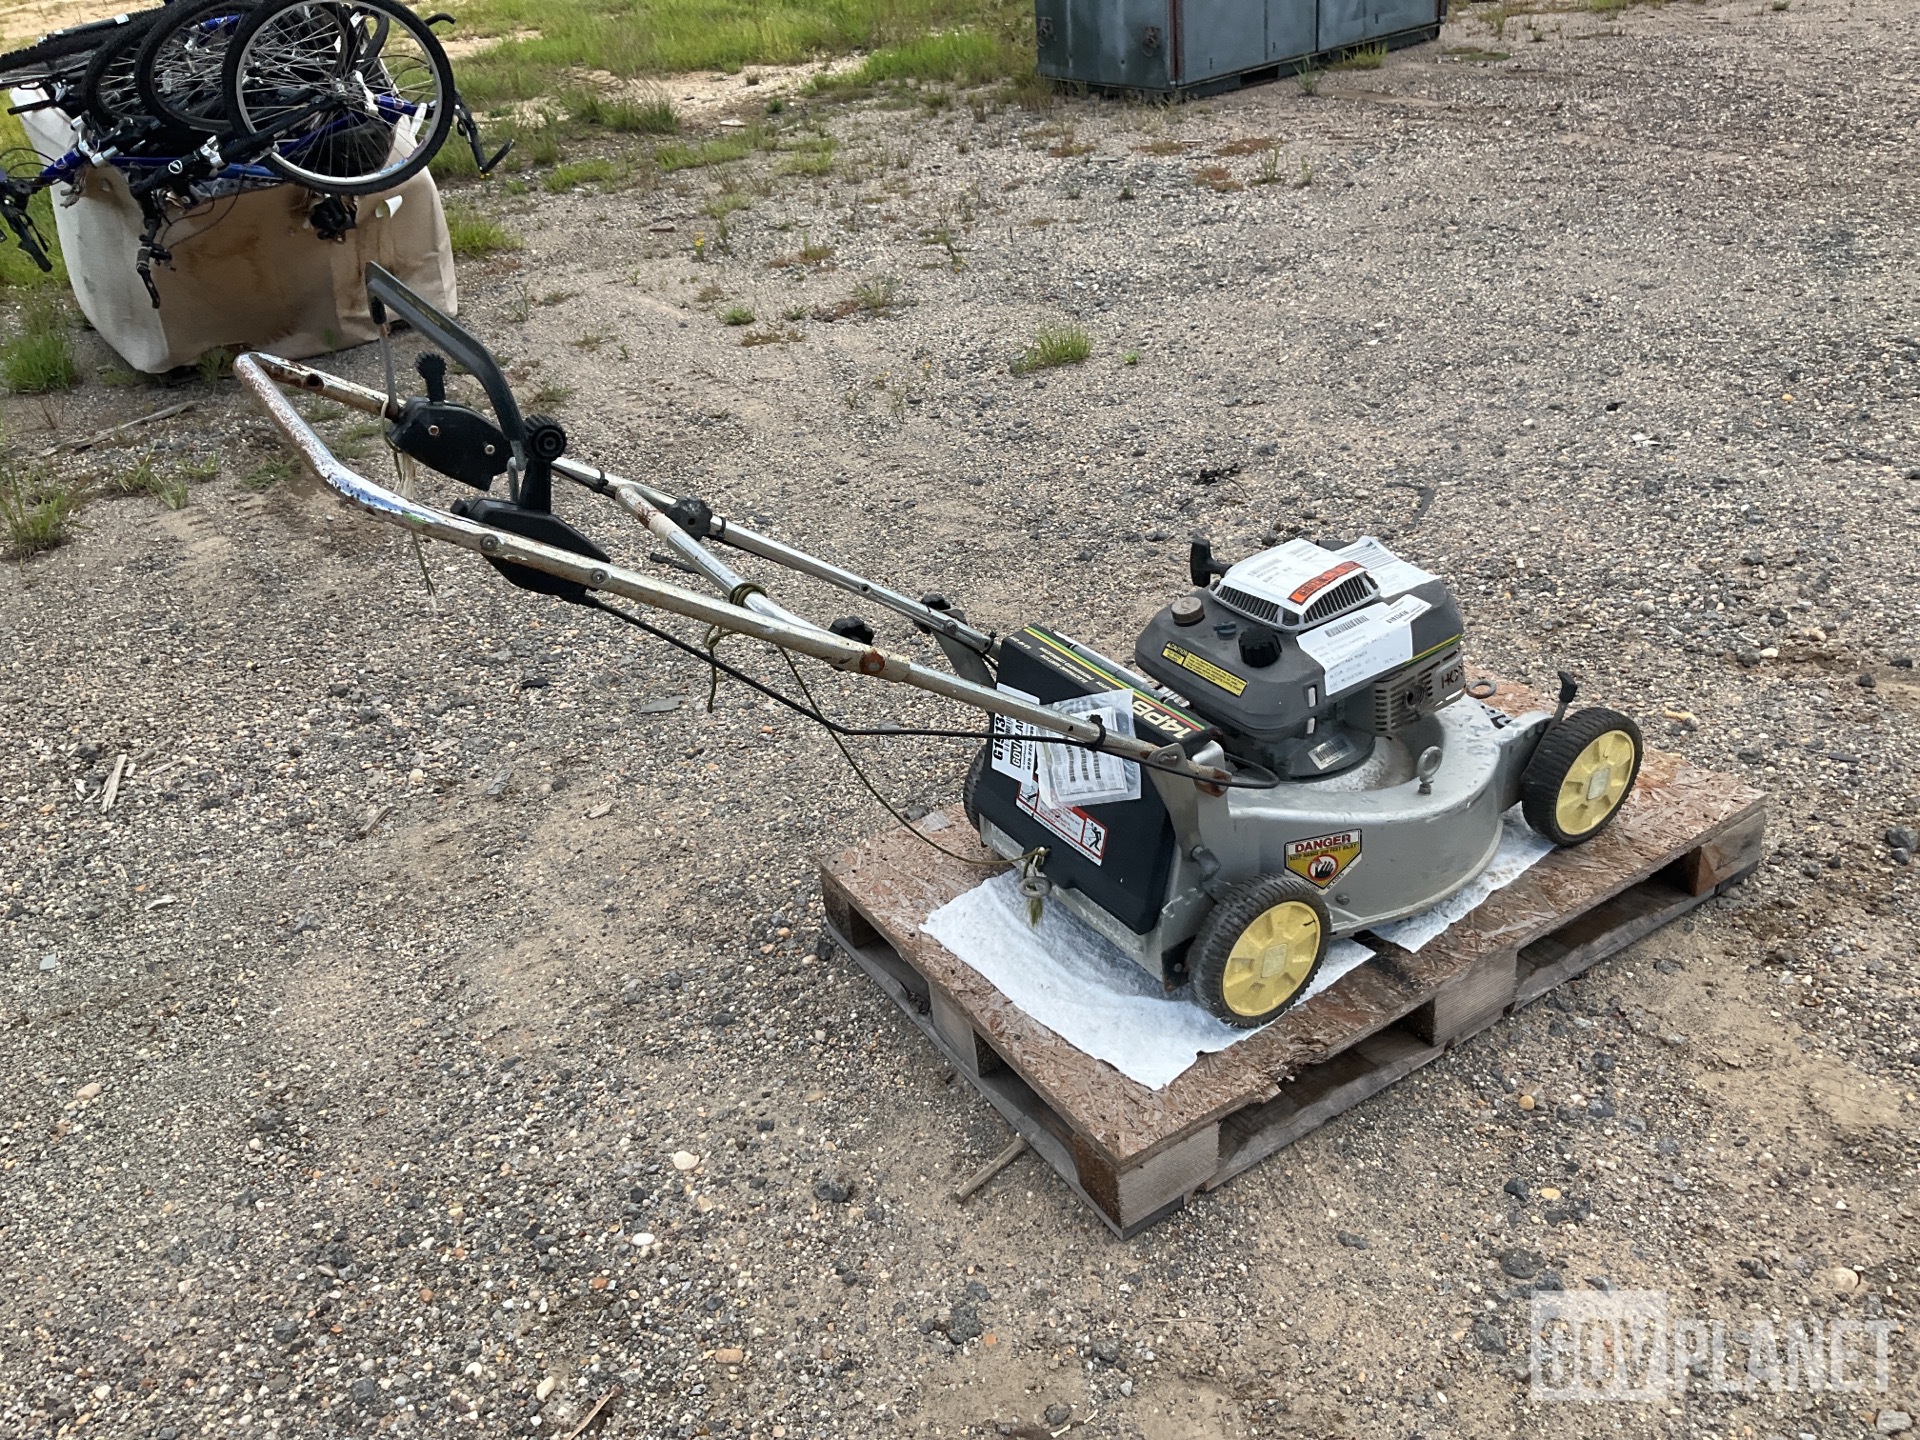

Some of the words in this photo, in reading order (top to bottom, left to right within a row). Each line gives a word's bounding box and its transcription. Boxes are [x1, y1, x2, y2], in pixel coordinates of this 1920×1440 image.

[1132, 700, 1192, 739] 14PB
[993, 714, 1006, 761] G1913
[1011, 742, 1022, 768] GOV
[1295, 833, 1351, 853] DANGER
